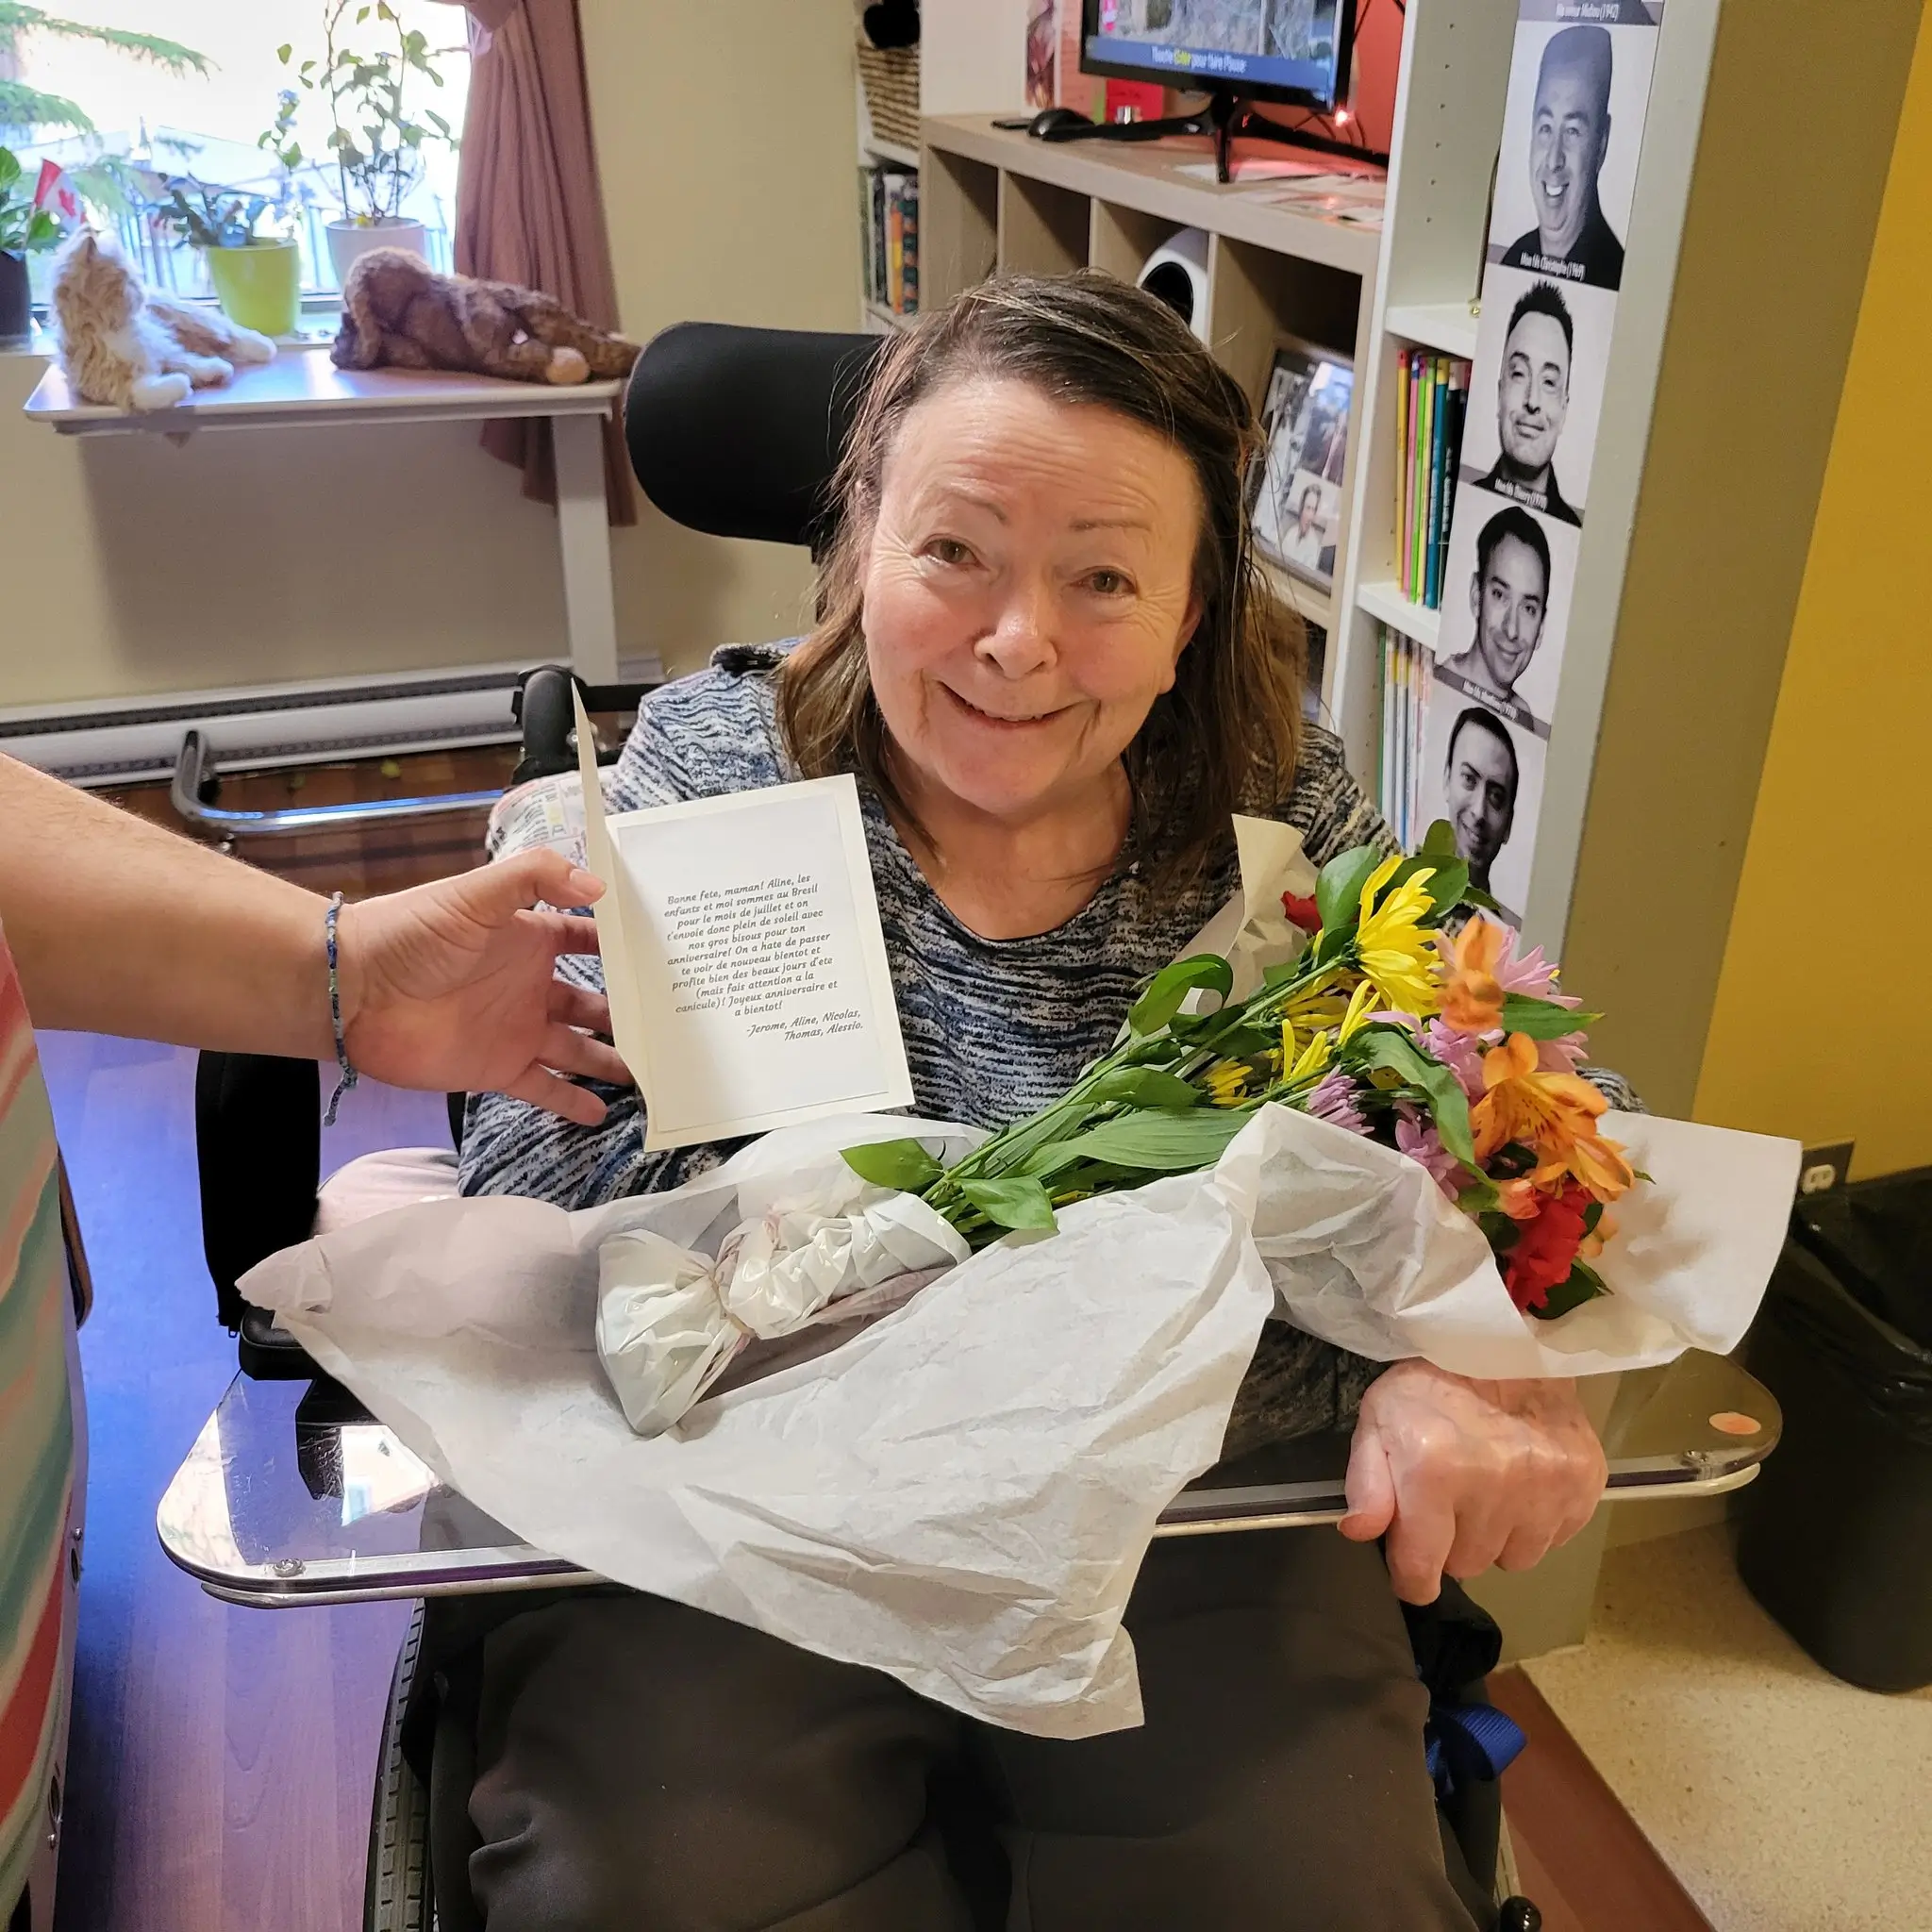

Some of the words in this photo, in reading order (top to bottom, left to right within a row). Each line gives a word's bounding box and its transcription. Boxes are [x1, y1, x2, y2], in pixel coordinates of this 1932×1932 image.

[664, 906, 701, 917] enfants
[703, 902, 713, 911] et
[715, 898, 734, 909] moi
[736, 893, 774, 907] sommes
[776, 891, 789, 899] au
[791, 883, 818, 897] Bresil
[667, 894, 697, 905] Bonne
[699, 890, 722, 901] fete,
[724, 880, 764, 895] maman!
[767, 878, 794, 889] Aline,
[797, 874, 811, 884] les
[667, 927, 704, 941] t'envoie
[707, 924, 730, 935] donc
[732, 919, 757, 933] plein
[759, 916, 772, 926] de
[774, 910, 799, 924] soleil
[801, 910, 824, 920] avec
[676, 917, 701, 930] pour
[702, 913, 711, 924] le
[714, 909, 737, 922] mois
[740, 907, 751, 918] de
[753, 903, 782, 918] juillet
[784, 901, 794, 910] et
[796, 900, 808, 908] on
[667, 947, 732, 965] anniversaire!
[735, 945, 748, 955] On
[760, 941, 782, 951] hate
[785, 936, 796, 947] de
[798, 933, 830, 947] passer
[688, 941, 706, 950] nos
[708, 938, 729, 950] gros
[731, 932, 762, 943] bisous
[763, 927, 788, 941] pour
[790, 924, 806, 934] ton
[672, 976, 706, 991] profite
[708, 973, 729, 984] bien
[732, 969, 749, 980] des
[751, 965, 780, 977] beaux
[781, 961, 808, 974] jours
[809, 957, 833, 967] d'ete
[693, 962, 714, 974] voir
[715, 959, 727, 971] de
[730, 955, 771, 968] nouveau
[774, 948, 808, 961] bientot
[810, 946, 821, 955] et
[675, 996, 726, 1013] canicule)!
[727, 993, 762, 1008] Joyeux
[764, 982, 824, 999] anniversaire
[827, 980, 838, 990] et
[695, 986, 724, 999] (mais
[726, 982, 745, 994] fais
[748, 975, 792, 990] attention
[805, 970, 814, 981] la
[743, 1000, 783, 1015] bientot!
[746, 1022, 788, 1037] -Jerome,
[790, 1016, 819, 1027] Aline,
[822, 1008, 860, 1023] Nicolas,
[784, 1028, 824, 1041] Thomas,
[826, 1020, 863, 1034] Alessio.
